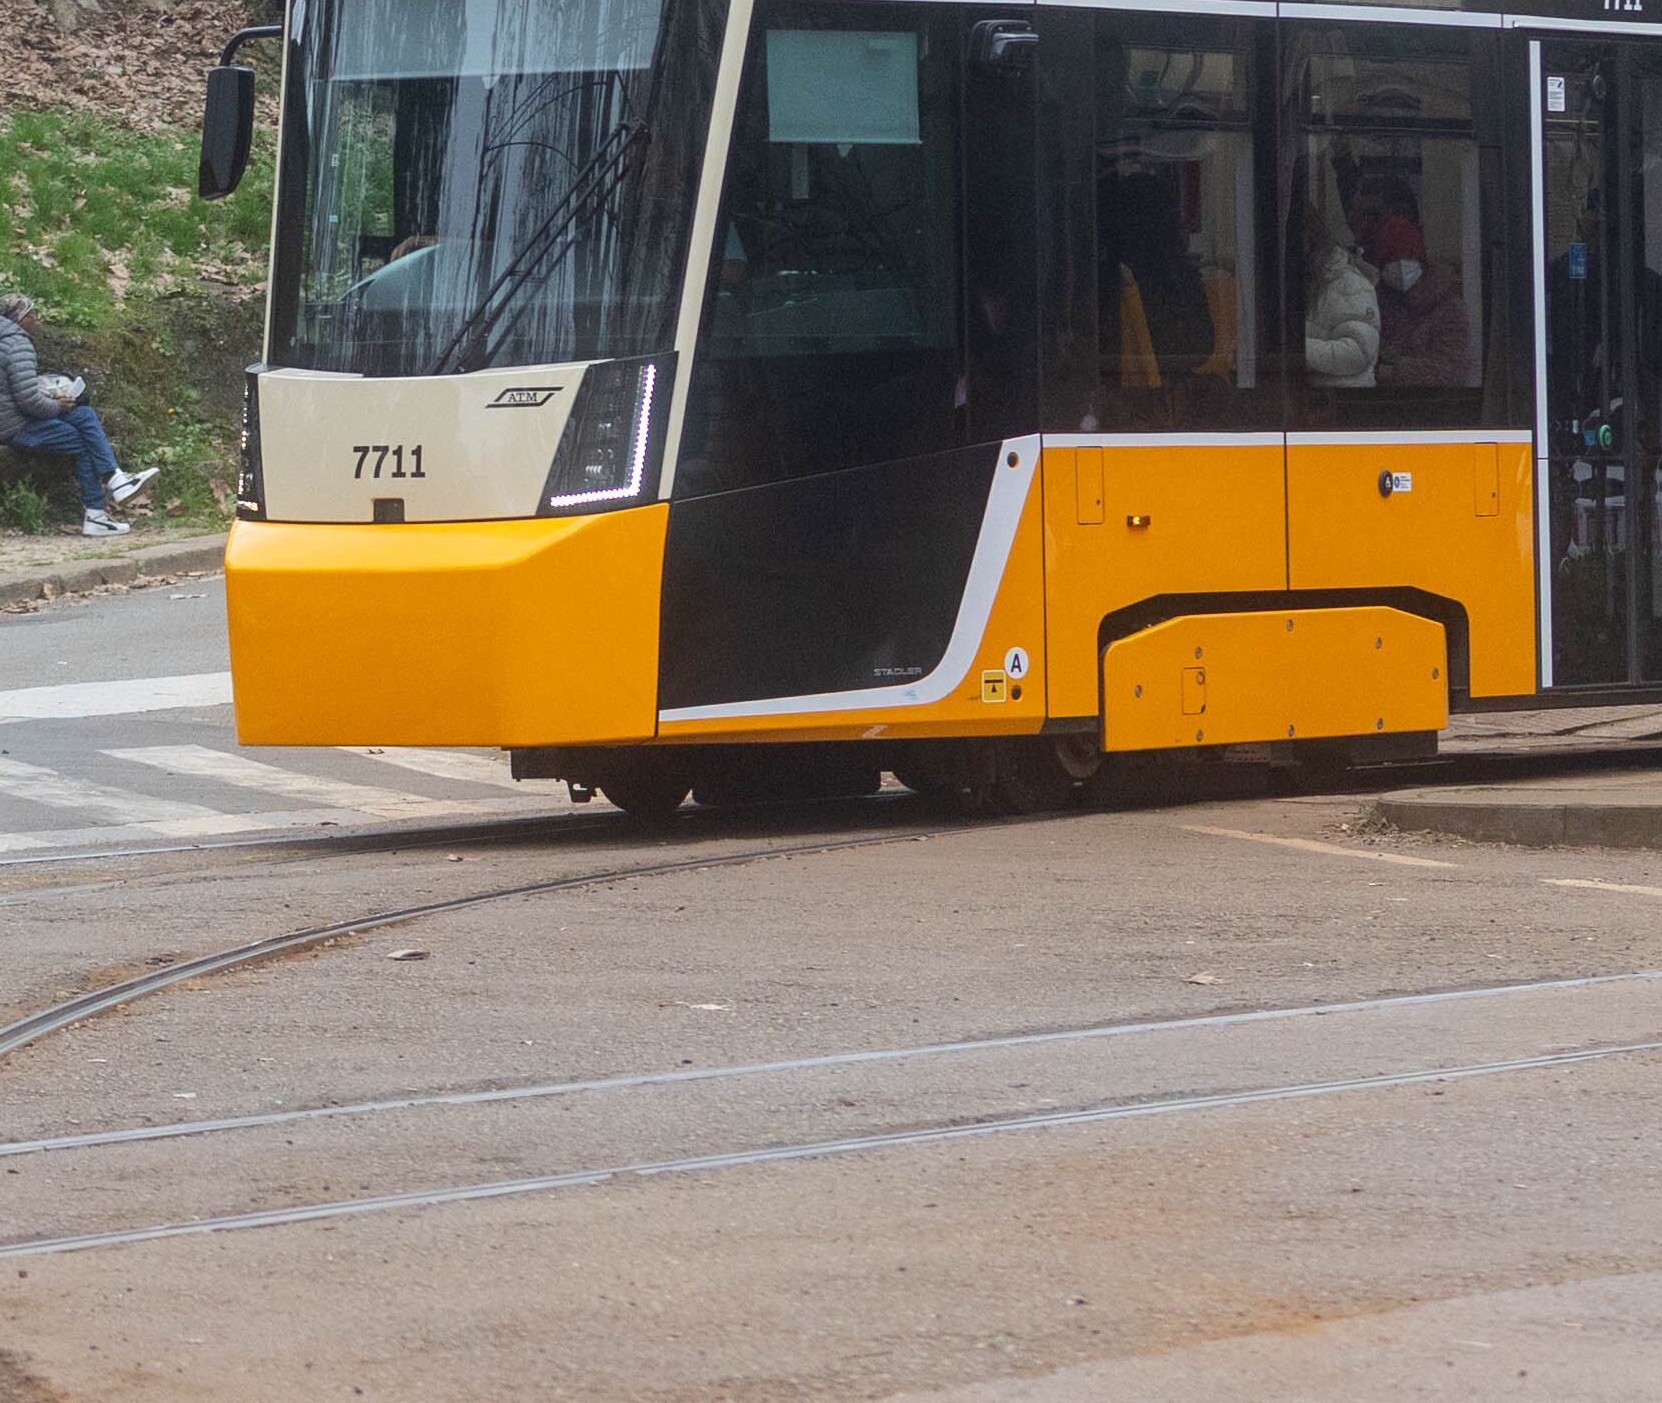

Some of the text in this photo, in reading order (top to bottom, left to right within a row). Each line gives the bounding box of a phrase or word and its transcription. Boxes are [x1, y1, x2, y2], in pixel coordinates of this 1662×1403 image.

[507, 392, 538, 403] ATM
[353, 444, 425, 478] 7711
[1010, 653, 1022, 673] A
